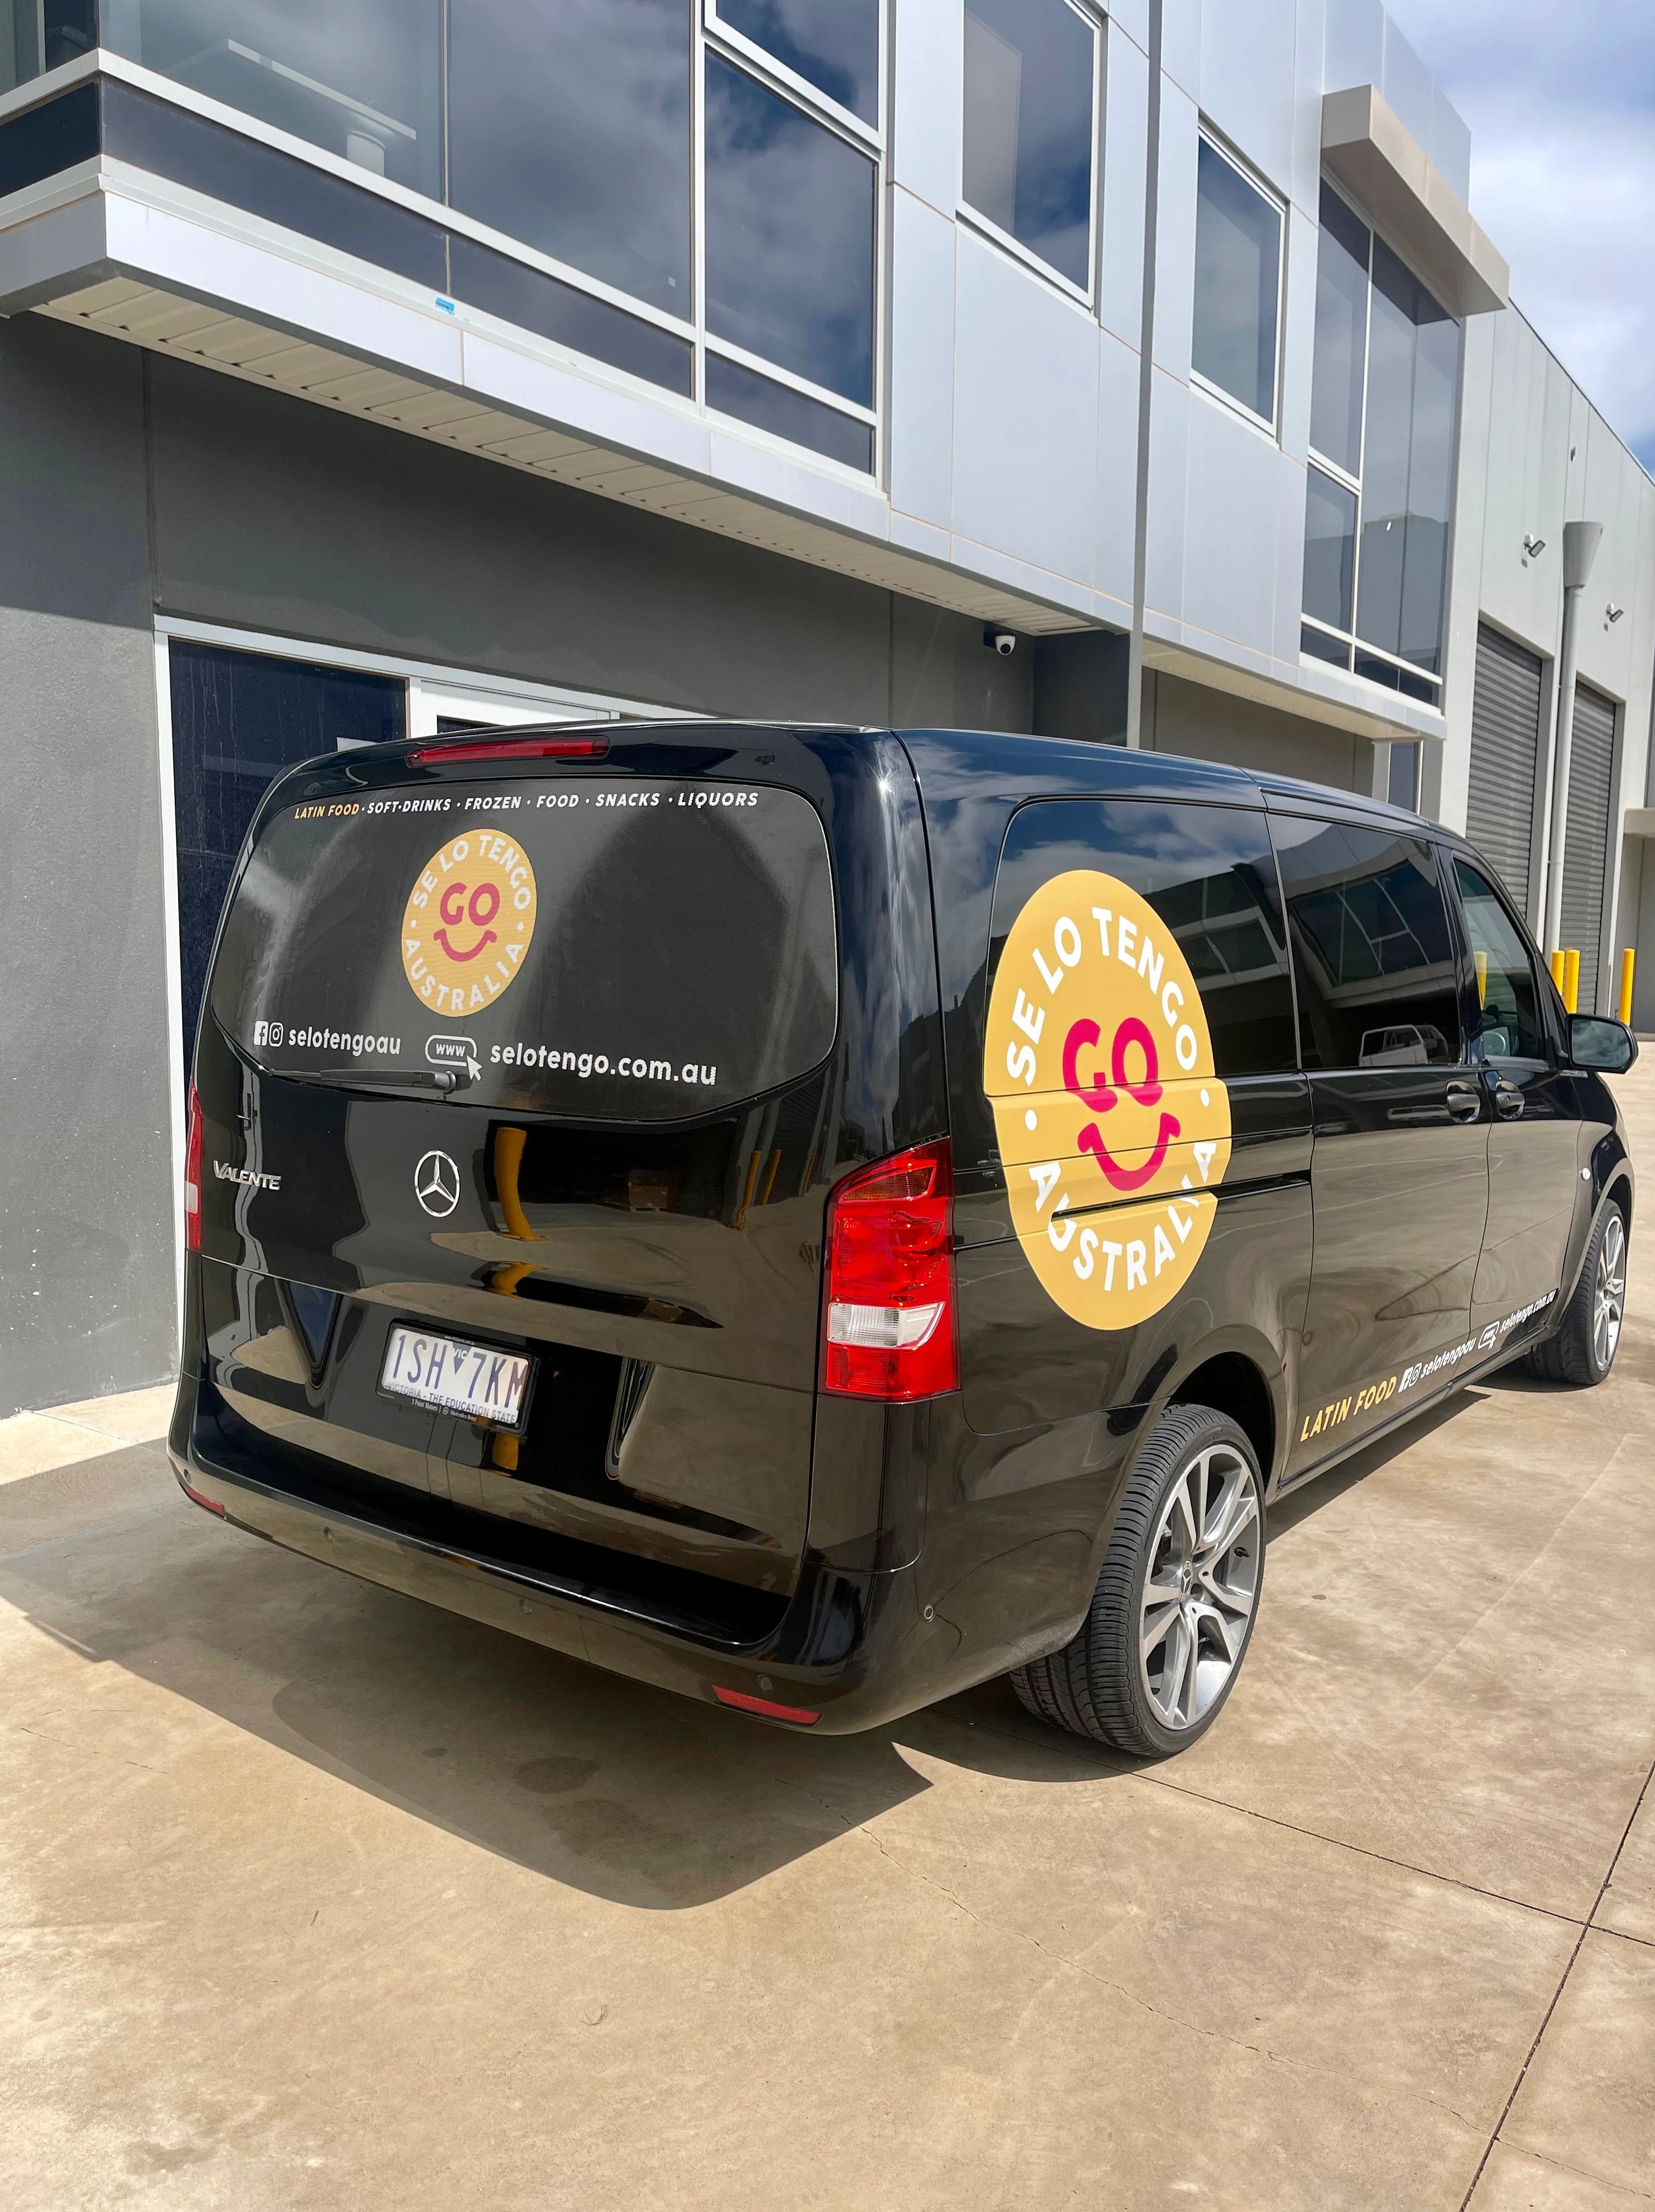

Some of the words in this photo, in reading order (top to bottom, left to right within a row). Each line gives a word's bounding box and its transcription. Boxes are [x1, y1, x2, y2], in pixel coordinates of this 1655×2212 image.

[295, 805, 325, 819] LATIN
[328, 803, 359, 816] FOOD
[464, 796, 522, 810] FROZEN
[536, 794, 579, 809] FOOD
[595, 792, 660, 807] SNACKS
[678, 792, 759, 809] LIQUORS
[413, 870, 438, 909] SE
[439, 840, 469, 872] LO
[440, 882, 501, 926] GO
[405, 939, 524, 1010] AUSTRALIA
[1006, 987, 1046, 1087] SE
[1031, 916, 1082, 995] LO
[1091, 906, 1197, 1071] TENGO
[288, 1026, 401, 1057] selotengoau
[435, 1043, 466, 1057] www
[490, 1042, 717, 1085] selotengo.com.au
[1062, 1017, 1163, 1113] GO
[213, 1160, 282, 1191] VALENTE
[1028, 1142, 1217, 1291] AUSTRALIA
[1499, 1290, 1557, 1334] selotengo.com.au
[393, 1335, 448, 1389] 1SH
[453, 1348, 468, 1360] VIC
[468, 1352, 528, 1411] 7KM
[1420, 1337, 1477, 1379] selotengoau
[389, 1382, 420, 1398] VICTORIA
[429, 1393, 444, 1405] THE
[445, 1397, 489, 1418] EDUCATION
[491, 1410, 516, 1424] STATE
[1300, 1396, 1353, 1442] LATIN
[1353, 1376, 1397, 1416] FOOD
